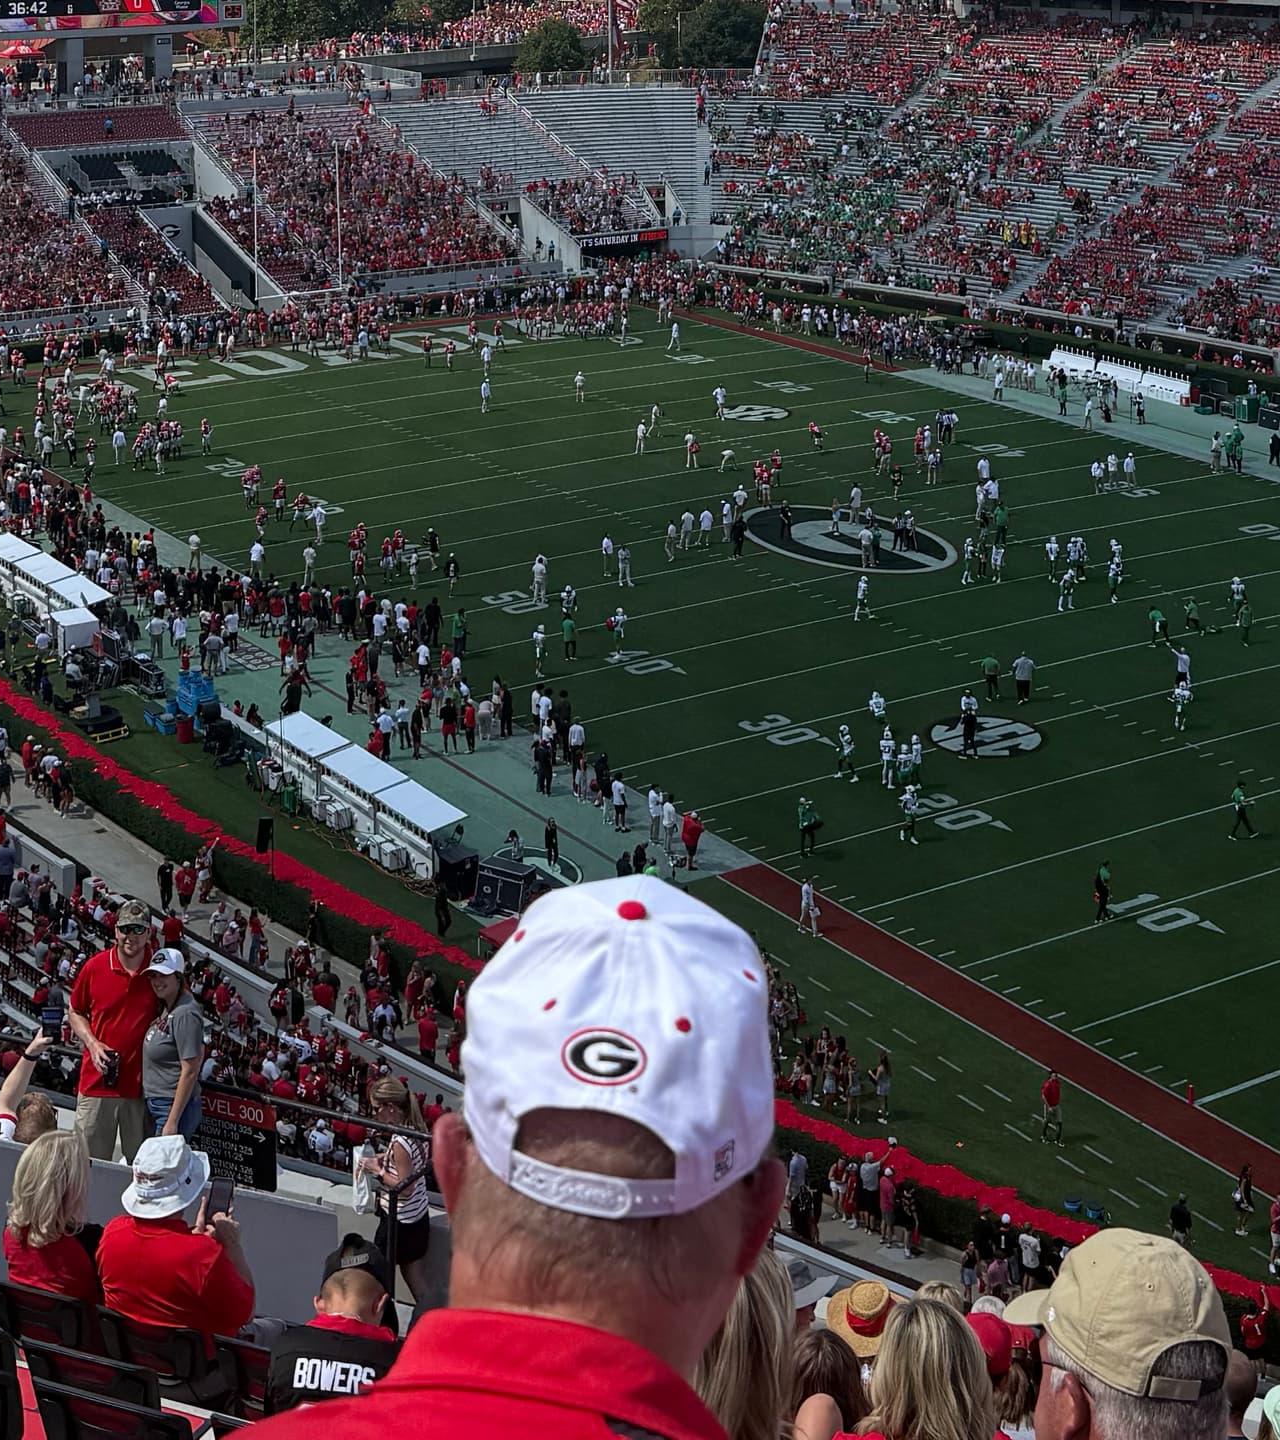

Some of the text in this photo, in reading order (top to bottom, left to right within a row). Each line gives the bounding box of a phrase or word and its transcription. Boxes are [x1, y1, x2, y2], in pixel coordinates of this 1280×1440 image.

[8, 2, 48, 16] 36:42
[225, 6, 240, 18] 25
[482, 590, 550, 615] 50
[738, 714, 820, 746] 30
[1106, 893, 1201, 932] 10
[567, 1035, 640, 1079] G
[201, 1096, 264, 1124] EVEL 300
[201, 1124, 240, 1140] ROW 1-10
[239, 1124, 252, 1136] 325
[200, 1144, 220, 1156] ROW
[201, 1136, 254, 1156] SECTION 325
[212, 1158, 238, 1171] CTION
[214, 1168, 235, 1180] ROW
[292, 1358, 376, 1395] BOWERS
